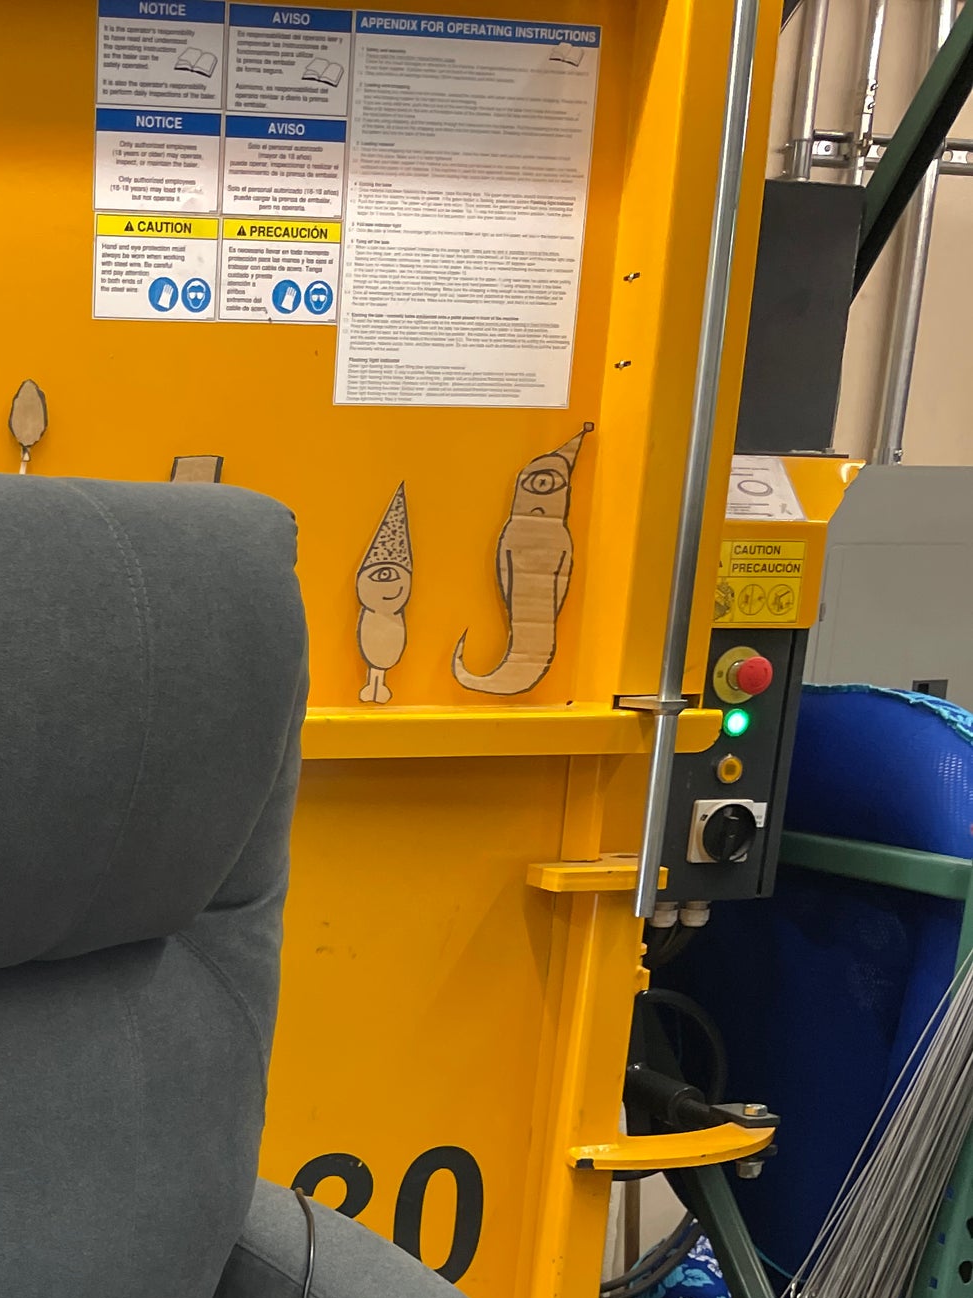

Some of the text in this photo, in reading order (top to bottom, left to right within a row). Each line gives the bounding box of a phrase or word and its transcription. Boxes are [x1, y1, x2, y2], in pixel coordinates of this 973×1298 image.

[139, 2, 187, 16] NOTICE
[272, 12, 310, 25] AVISO
[361, 17, 596, 43] APPENDIX FOR OPERATING INSTRUCTIONS
[135, 116, 183, 129] NOTICE
[267, 122, 305, 135] AVISO
[137, 221, 192, 234] CAUTION
[249, 225, 328, 239] PRECAUCIÓN
[733, 545, 781, 555] CAUTION
[731, 561, 801, 573] PRECAUCIÓN
